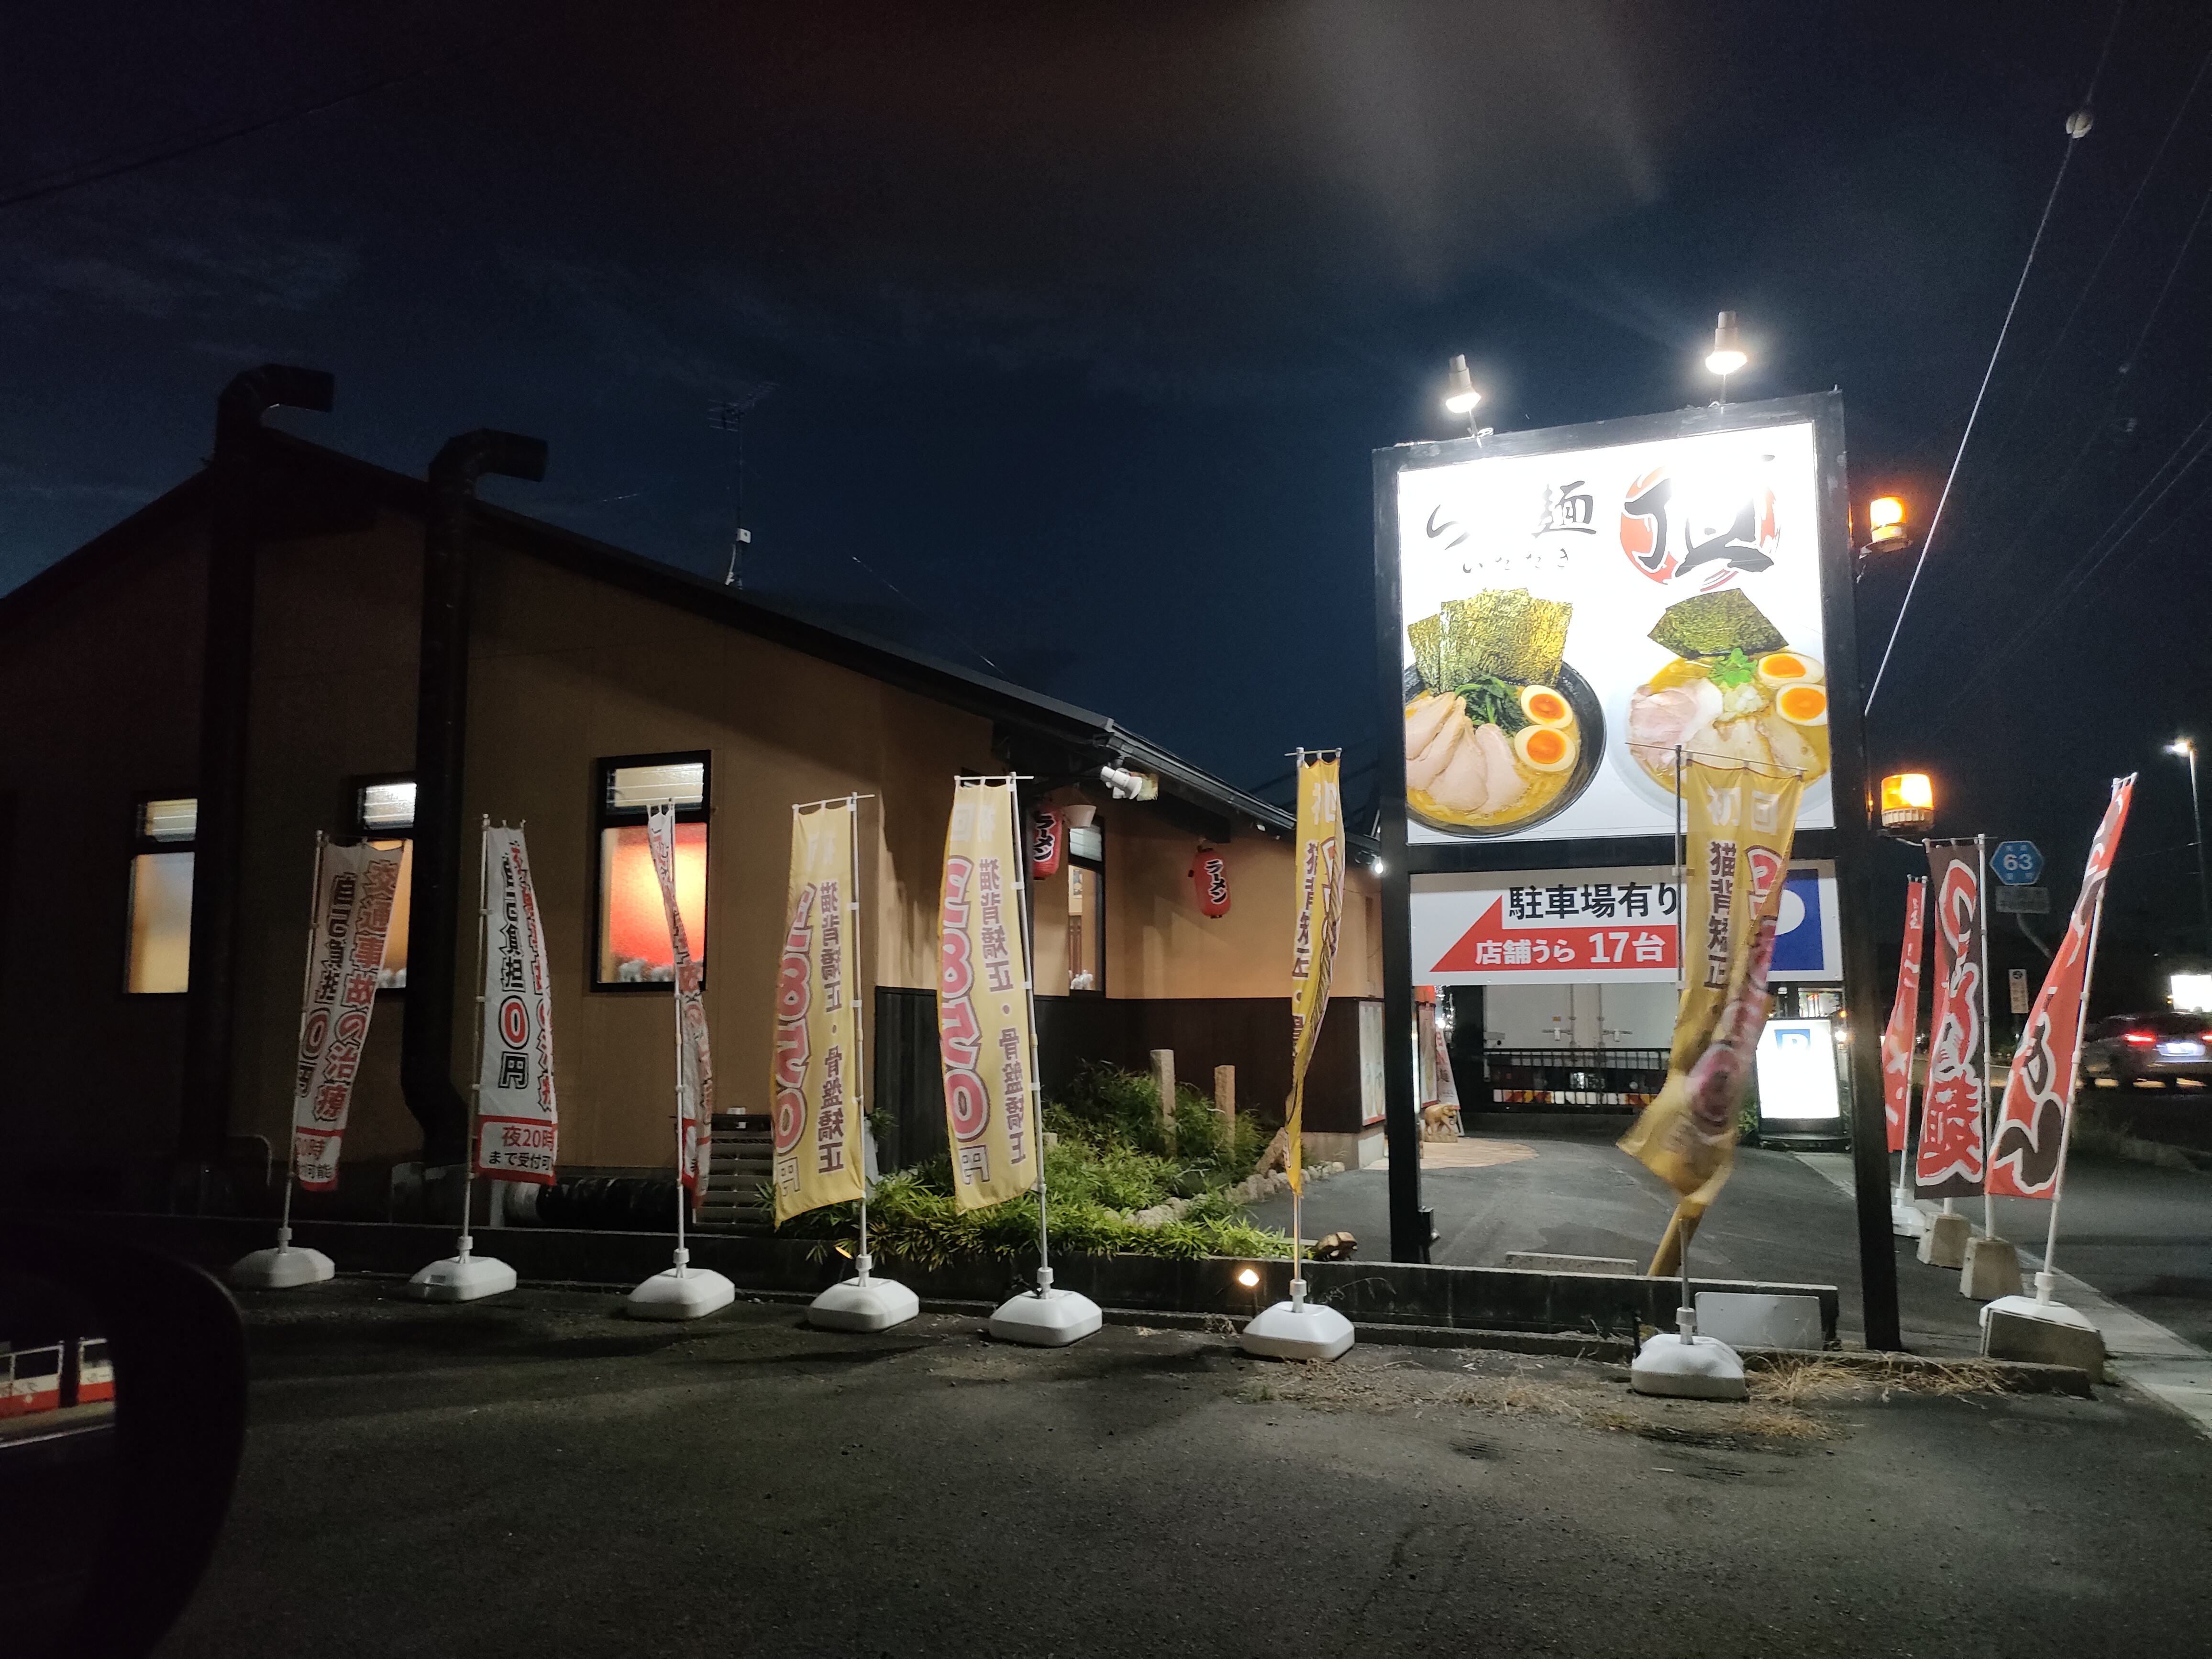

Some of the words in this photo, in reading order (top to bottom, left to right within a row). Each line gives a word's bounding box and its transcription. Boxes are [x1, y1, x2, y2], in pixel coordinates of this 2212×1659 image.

[1032, 812, 1056, 862] ラーメン
[1205, 859, 1228, 905] ラーメン
[2003, 853, 2033, 871] 63
[1509, 882, 1677, 920] 駐車場有り
[1475, 939, 1576, 965] 店舗うら
[1589, 931, 1666, 963] 17台
[314, 859, 398, 1122] 交通事故の治療
